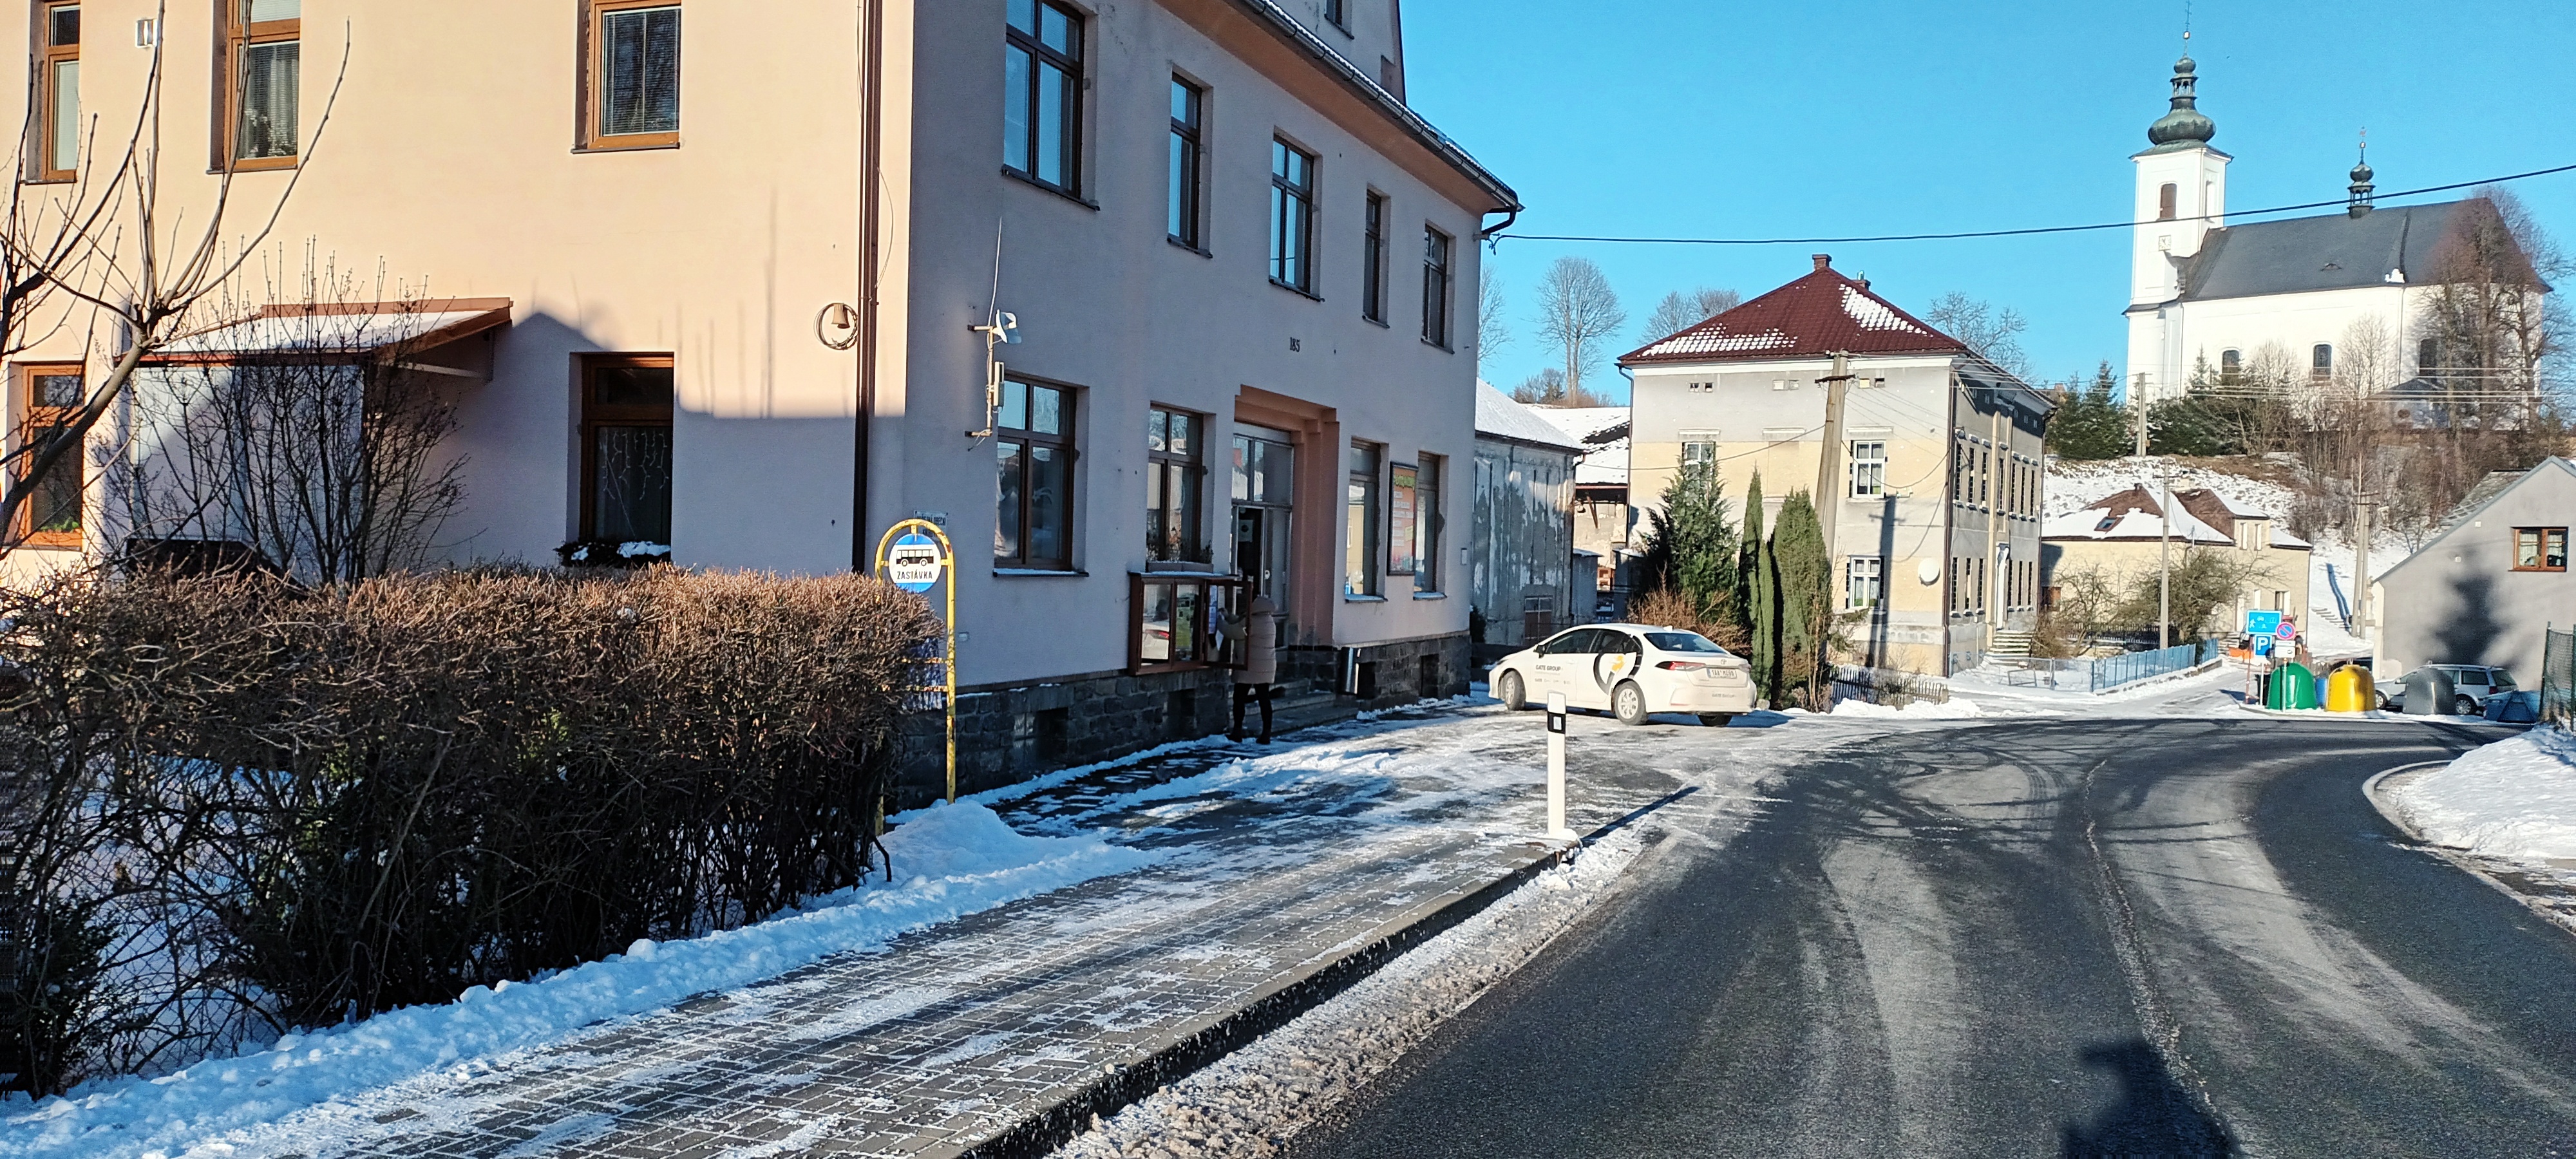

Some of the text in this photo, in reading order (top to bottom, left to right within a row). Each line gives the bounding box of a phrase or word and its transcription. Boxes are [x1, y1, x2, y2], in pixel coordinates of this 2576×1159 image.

[1290, 337, 1300, 352] 185
[897, 569, 933, 580] ZASTÁVKA
[2257, 637, 2268, 650] P
